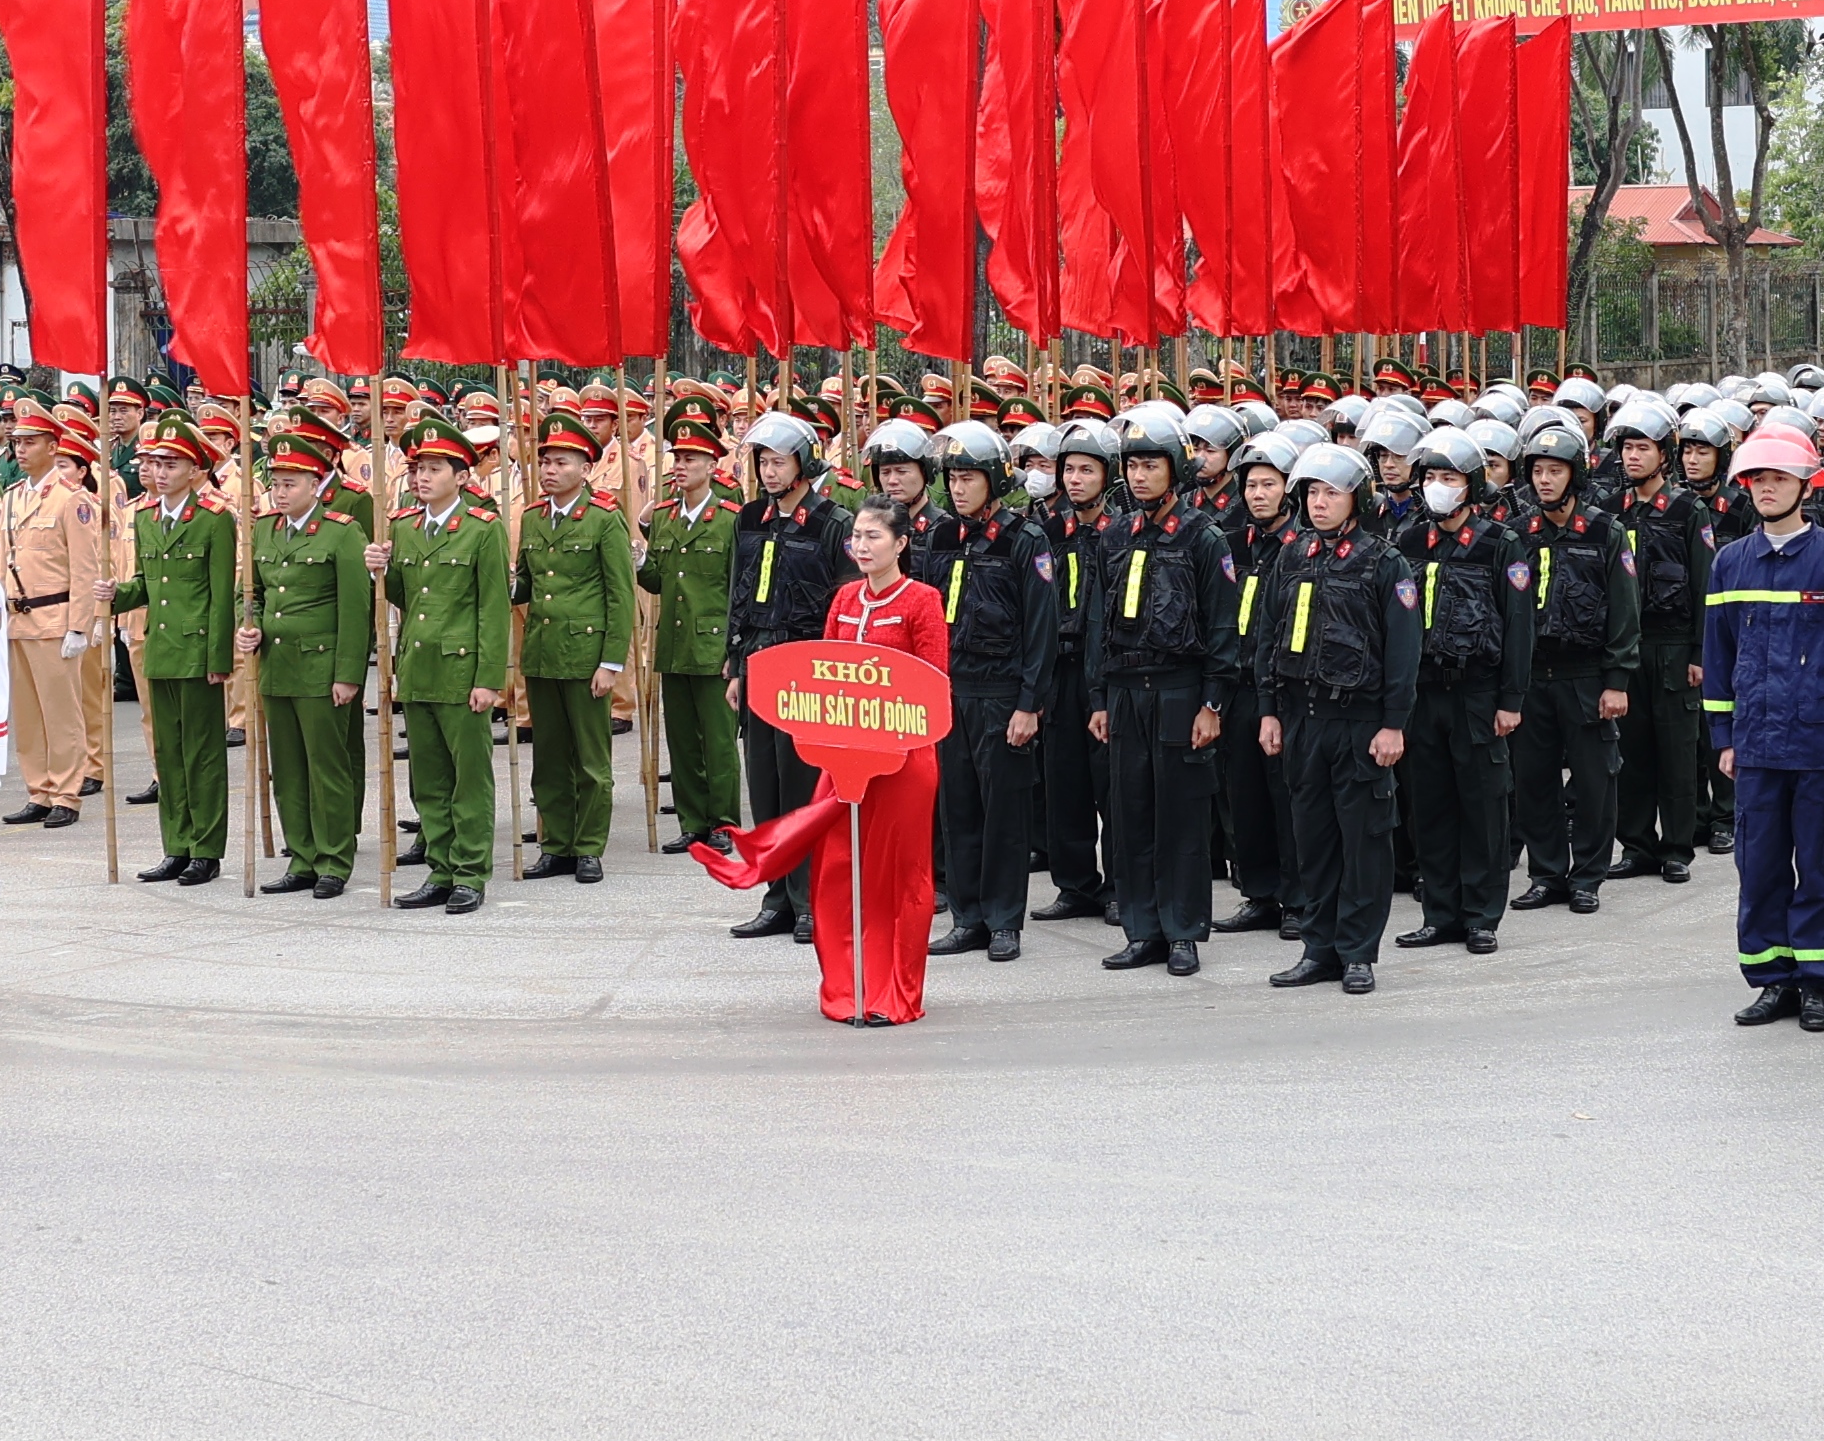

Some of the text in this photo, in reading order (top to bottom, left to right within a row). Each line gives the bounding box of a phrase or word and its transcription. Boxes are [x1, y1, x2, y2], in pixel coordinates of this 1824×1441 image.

[811, 656, 892, 687] KHỐI
[777, 680, 927, 740] CẢNH SÁT CƠ ĐỘNG
